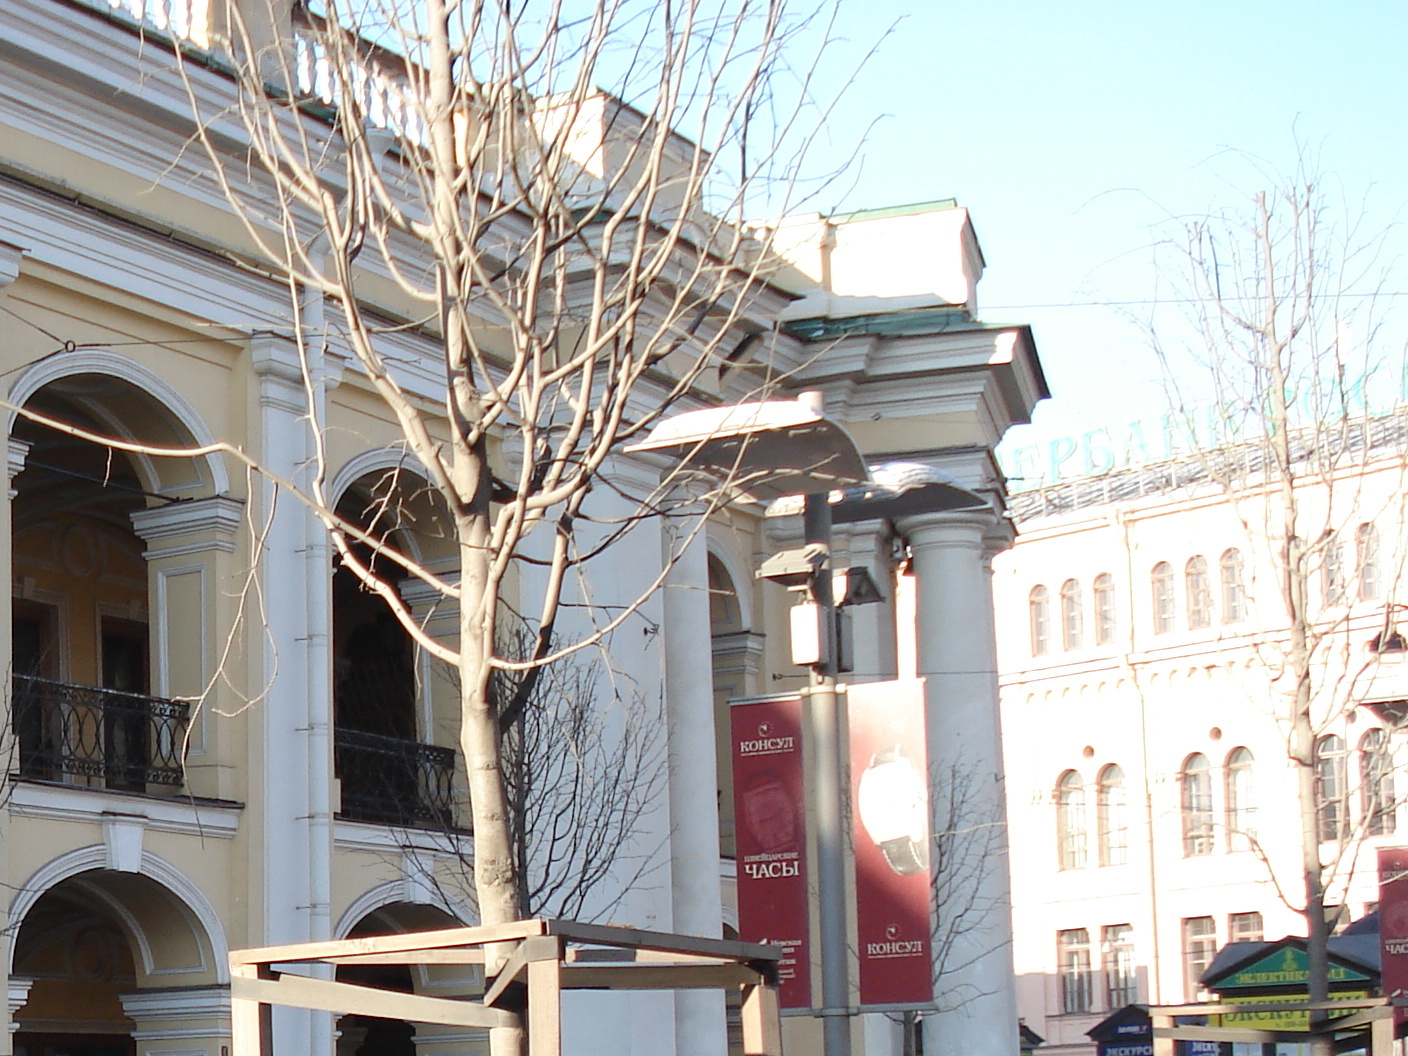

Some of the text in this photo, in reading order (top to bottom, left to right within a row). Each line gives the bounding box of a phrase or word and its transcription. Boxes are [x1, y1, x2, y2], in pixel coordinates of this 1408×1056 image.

[739, 737, 794, 753] КОНСУЛ
[744, 861, 800, 879] ЧАСЫ
[867, 941, 923, 955] КОНСУЛ
